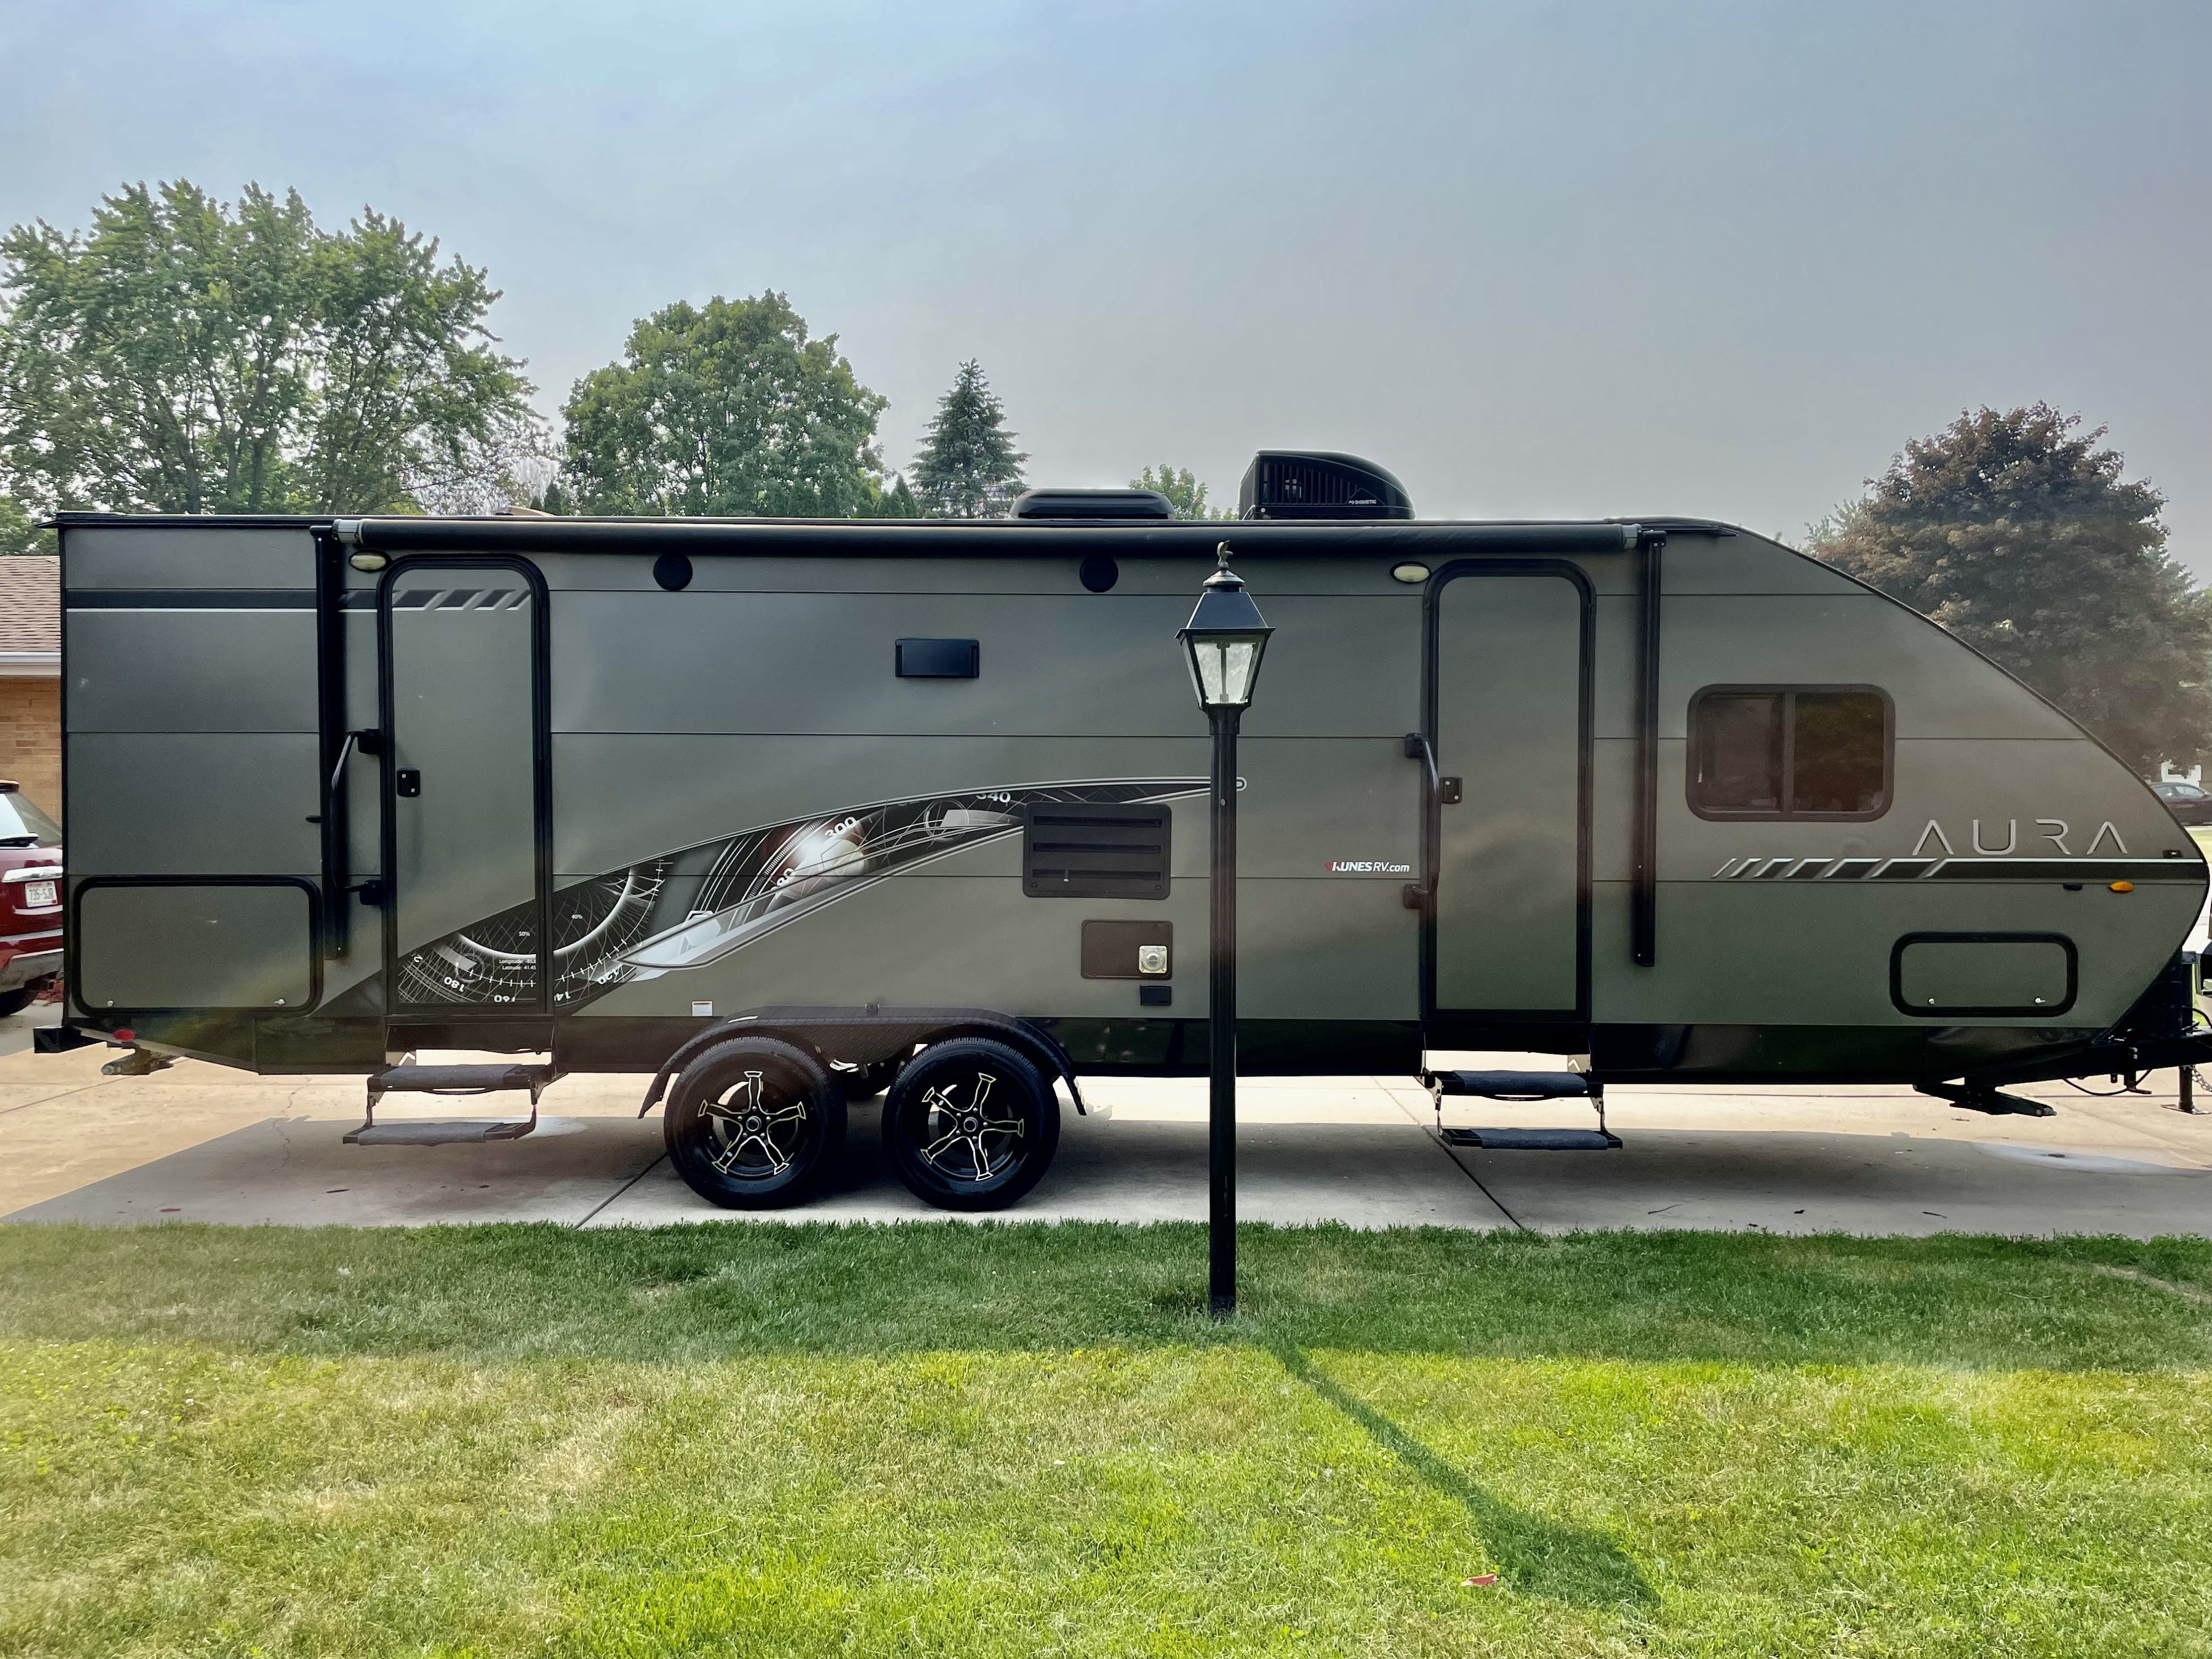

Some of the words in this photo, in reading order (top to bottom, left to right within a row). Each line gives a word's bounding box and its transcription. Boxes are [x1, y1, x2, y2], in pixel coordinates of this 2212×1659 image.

[825, 816, 857, 842] 300
[1912, 819, 2128, 855] AURA
[444, 976, 465, 993] 180
[554, 991, 571, 1001] 14
